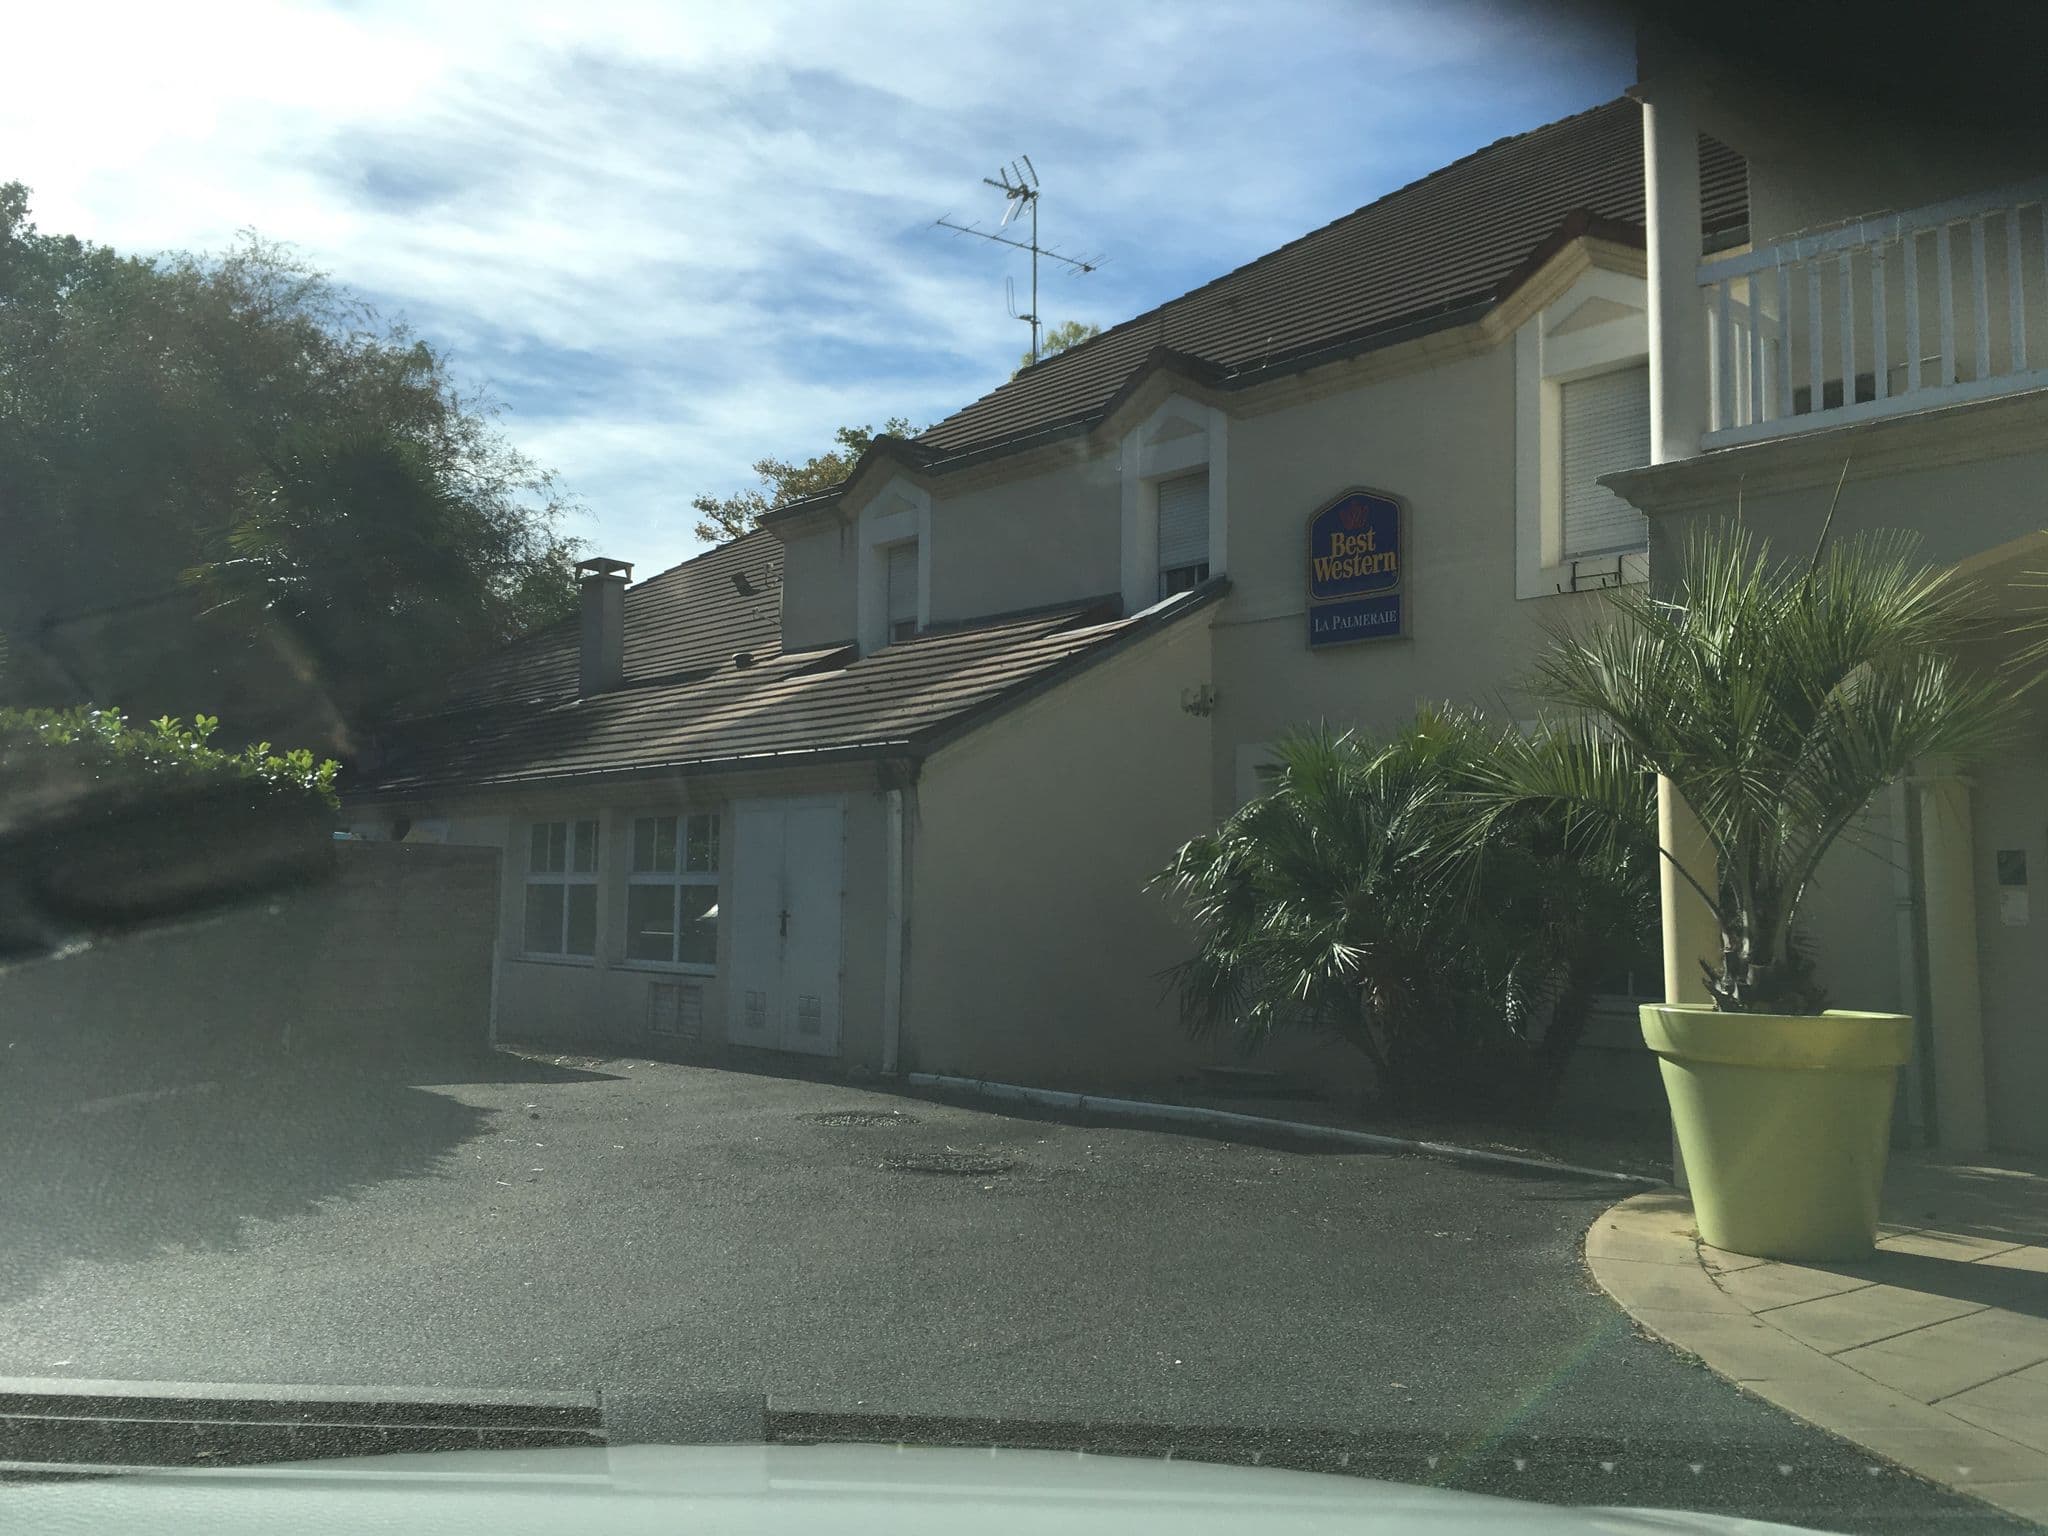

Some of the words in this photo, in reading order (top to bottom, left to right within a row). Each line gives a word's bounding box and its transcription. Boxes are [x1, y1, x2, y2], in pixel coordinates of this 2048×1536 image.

[1331, 526, 1376, 558] Best
[1314, 551, 1397, 583] Western
[1315, 618, 1330, 632] LA
[1332, 610, 1397, 630] PALMERAIE
